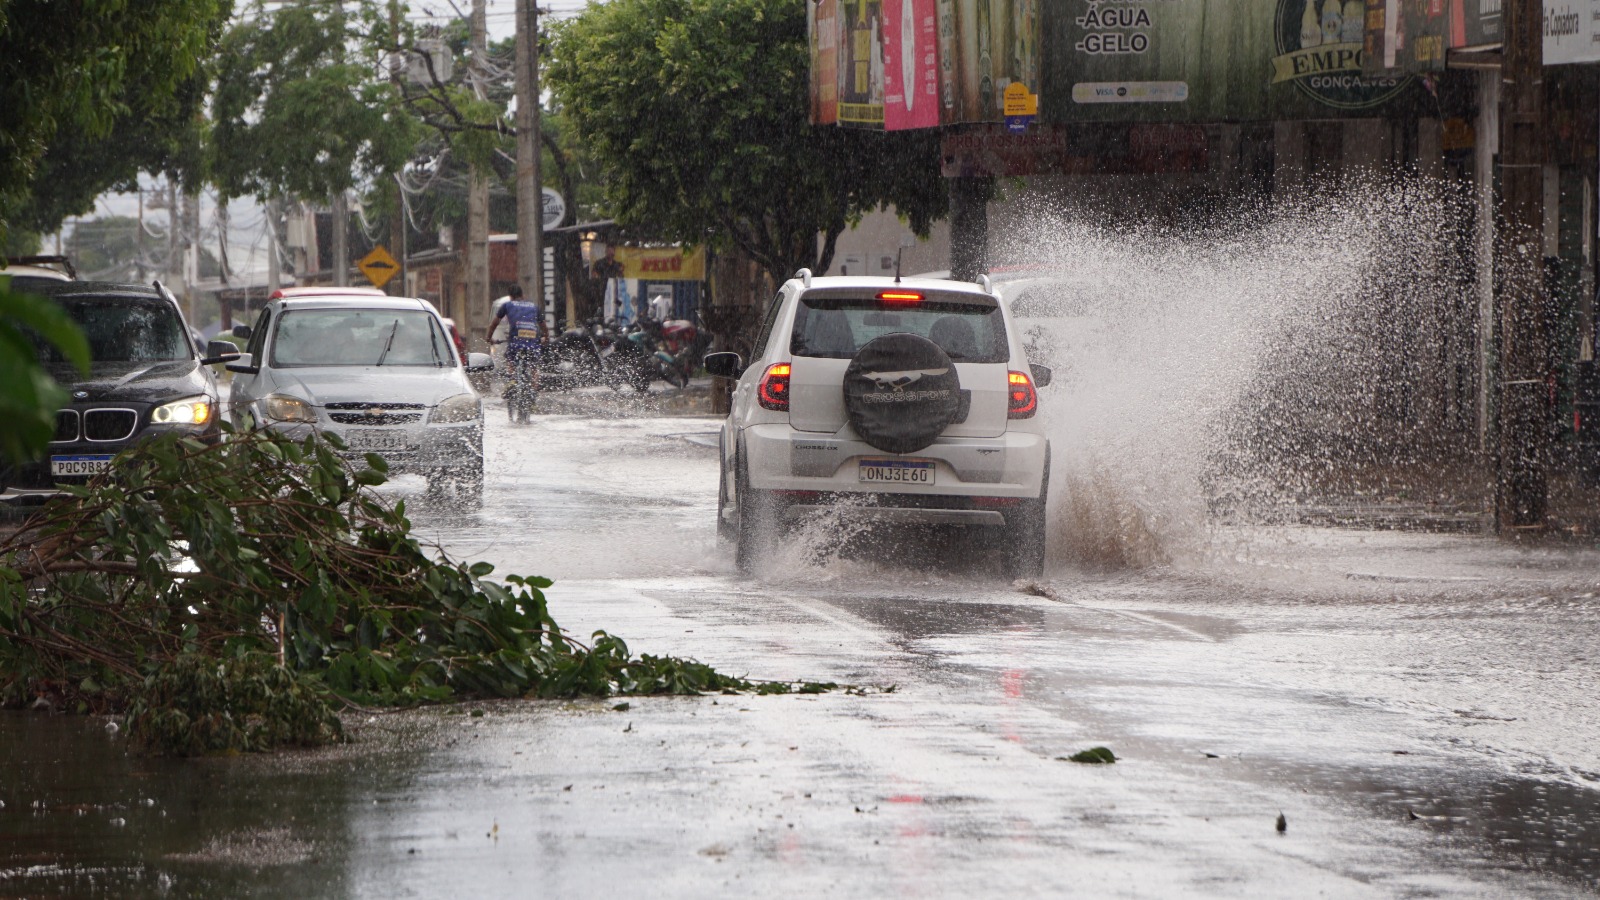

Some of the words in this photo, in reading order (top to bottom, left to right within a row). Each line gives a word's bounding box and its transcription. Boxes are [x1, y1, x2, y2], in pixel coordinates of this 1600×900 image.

[1076, 4, 1151, 28] -ÁGUA
[1550, 4, 1579, 46] Copiadora
[1075, 32, 1149, 54] -GELO
[1096, 88, 1114, 96] VISA
[862, 389, 950, 404] CROSSFOX
[867, 467, 927, 482] ONJ3E60
